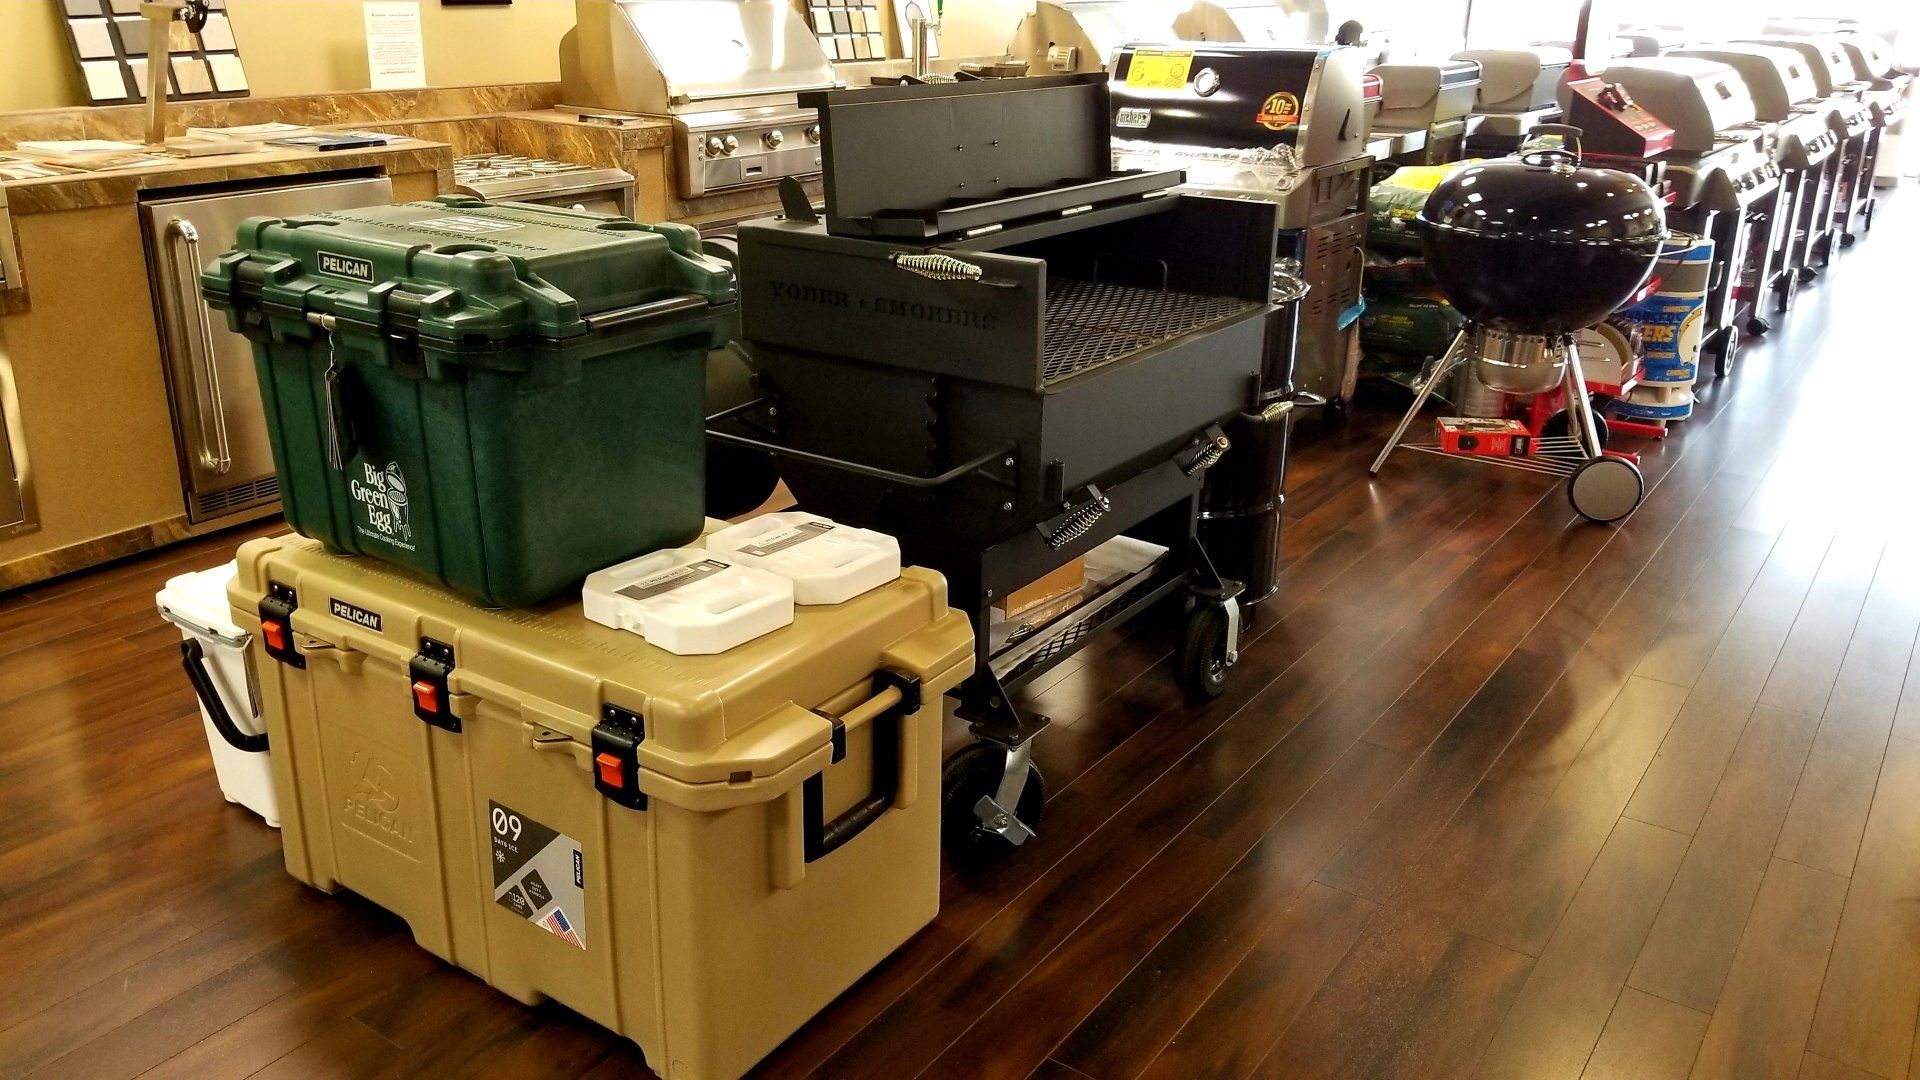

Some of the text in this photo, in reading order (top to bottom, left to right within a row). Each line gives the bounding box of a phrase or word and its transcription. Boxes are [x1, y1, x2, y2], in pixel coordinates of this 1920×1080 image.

[1269, 98, 1286, 114] 10
[322, 256, 368, 278] PELICAN
[769, 280, 998, 331] YODER SMOKERS
[363, 462, 387, 493] Big
[351, 479, 390, 510] Green
[366, 503, 393, 535] Egg
[333, 602, 378, 629] PELICAN
[344, 797, 414, 844] PELICAN
[492, 807, 522, 842] 09
[494, 836, 519, 854] DAYS ICE
